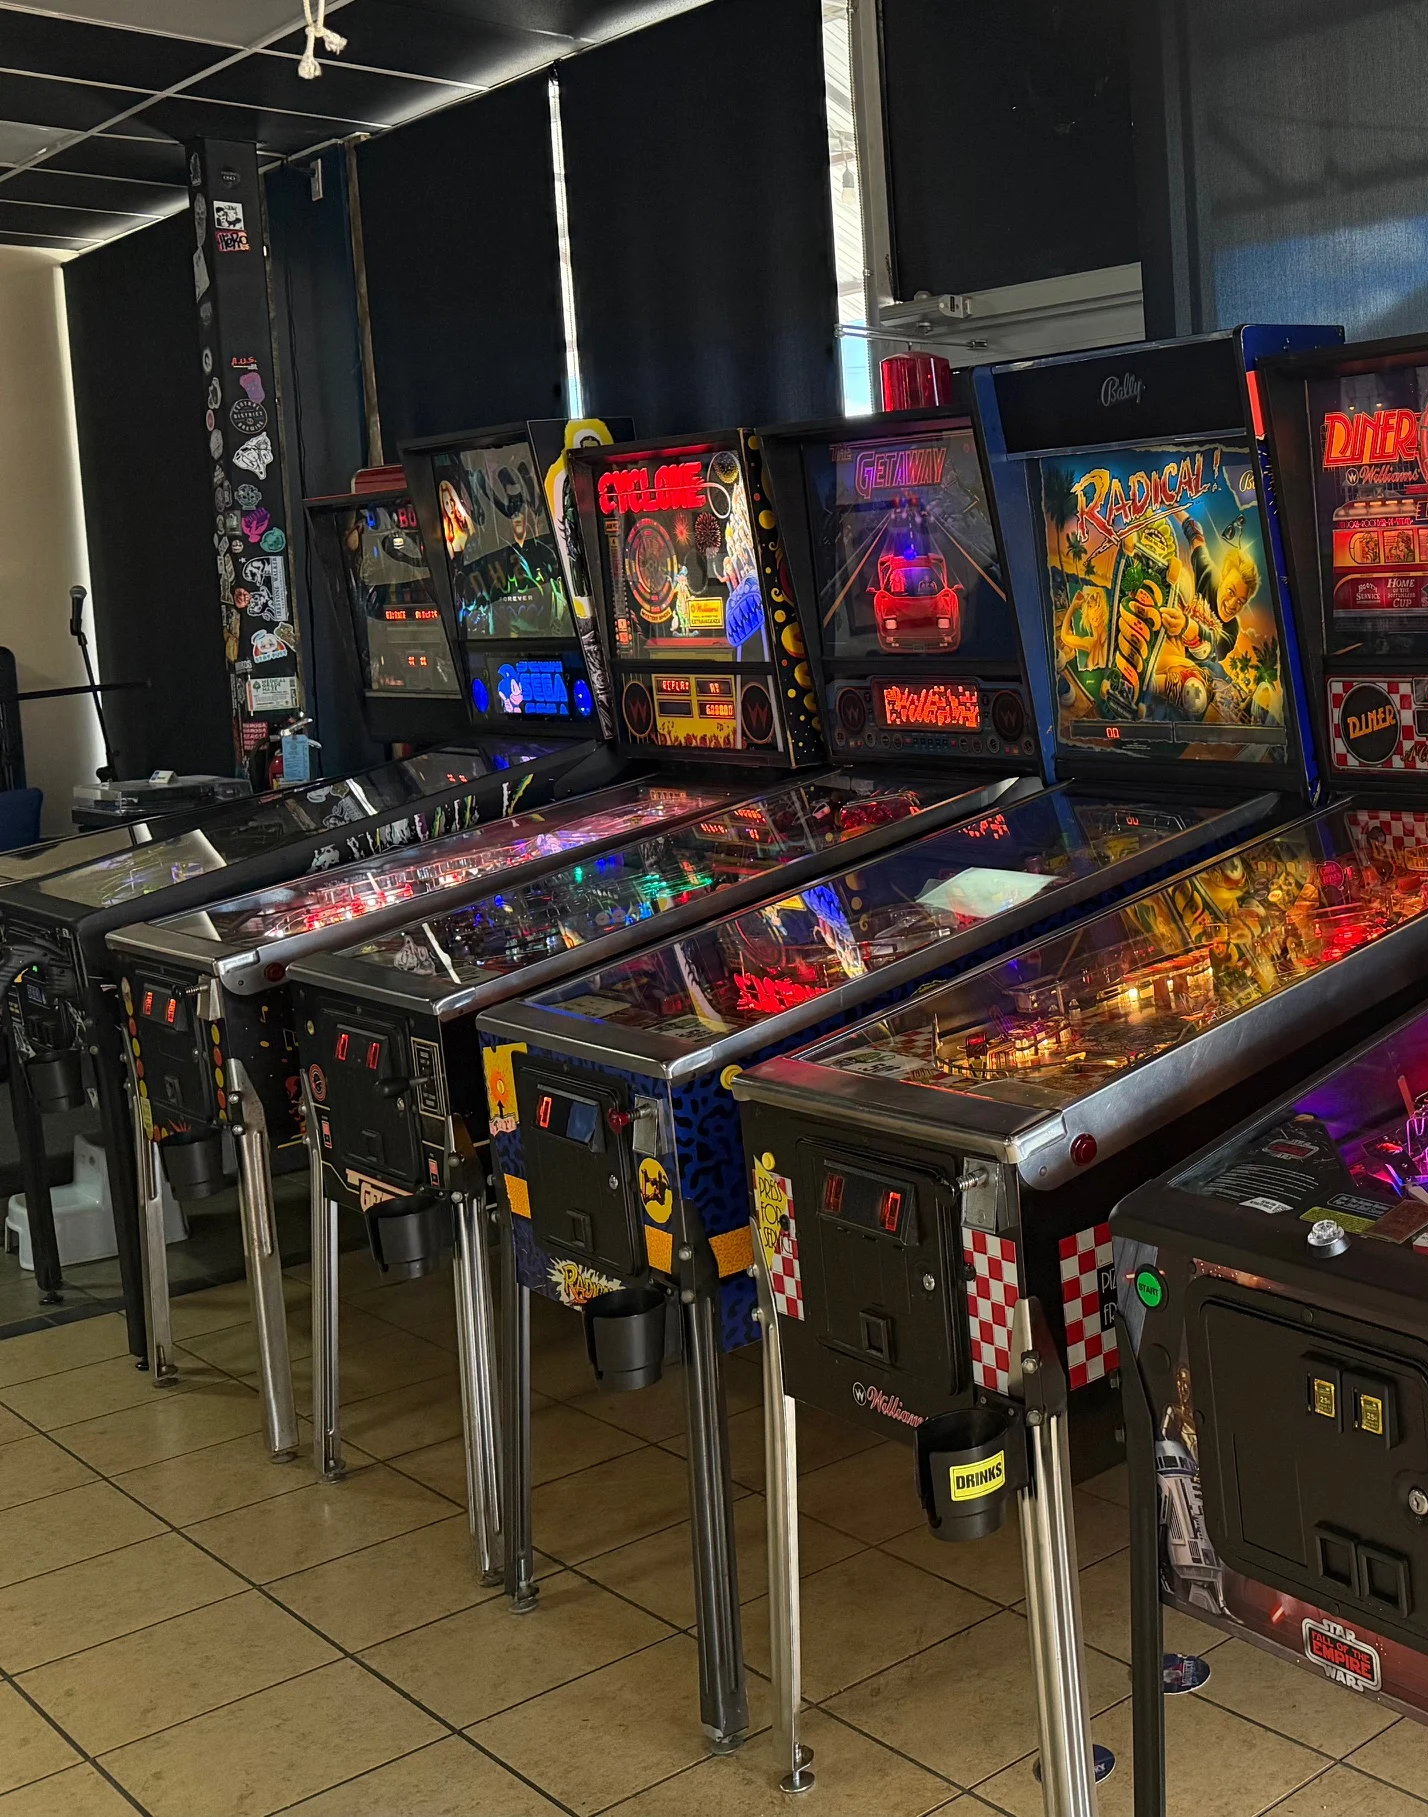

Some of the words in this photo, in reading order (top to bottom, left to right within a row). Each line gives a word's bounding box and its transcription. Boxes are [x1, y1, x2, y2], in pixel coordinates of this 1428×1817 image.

[1101, 373, 1143, 406] Bally
[1323, 409, 1419, 467] DINER
[830, 443, 852, 463] THE
[854, 447, 948, 500] GETAWAY
[1359, 466, 1420, 484] Williams
[598, 461, 706, 515] CYCLONE
[1072, 448, 1222, 542] RADICAL!
[1387, 578, 1415, 588] HOME
[1393, 598, 1412, 608] CUP
[521, 673, 568, 701] SEGA
[1347, 705, 1396, 740] DINER
[758, 1176, 783, 1202] PRESS
[1138, 1282, 1159, 1297] START
[956, 1462, 1003, 1490] DRINKS
[1322, 1618, 1356, 1642] STAR
[1312, 1630, 1334, 1647] FALL
[1336, 1642, 1349, 1653] OF
[1352, 1649, 1371, 1664] THE
[1313, 1641, 1372, 1679] EMPIRE
[1324, 1664, 1364, 1692] WARS
